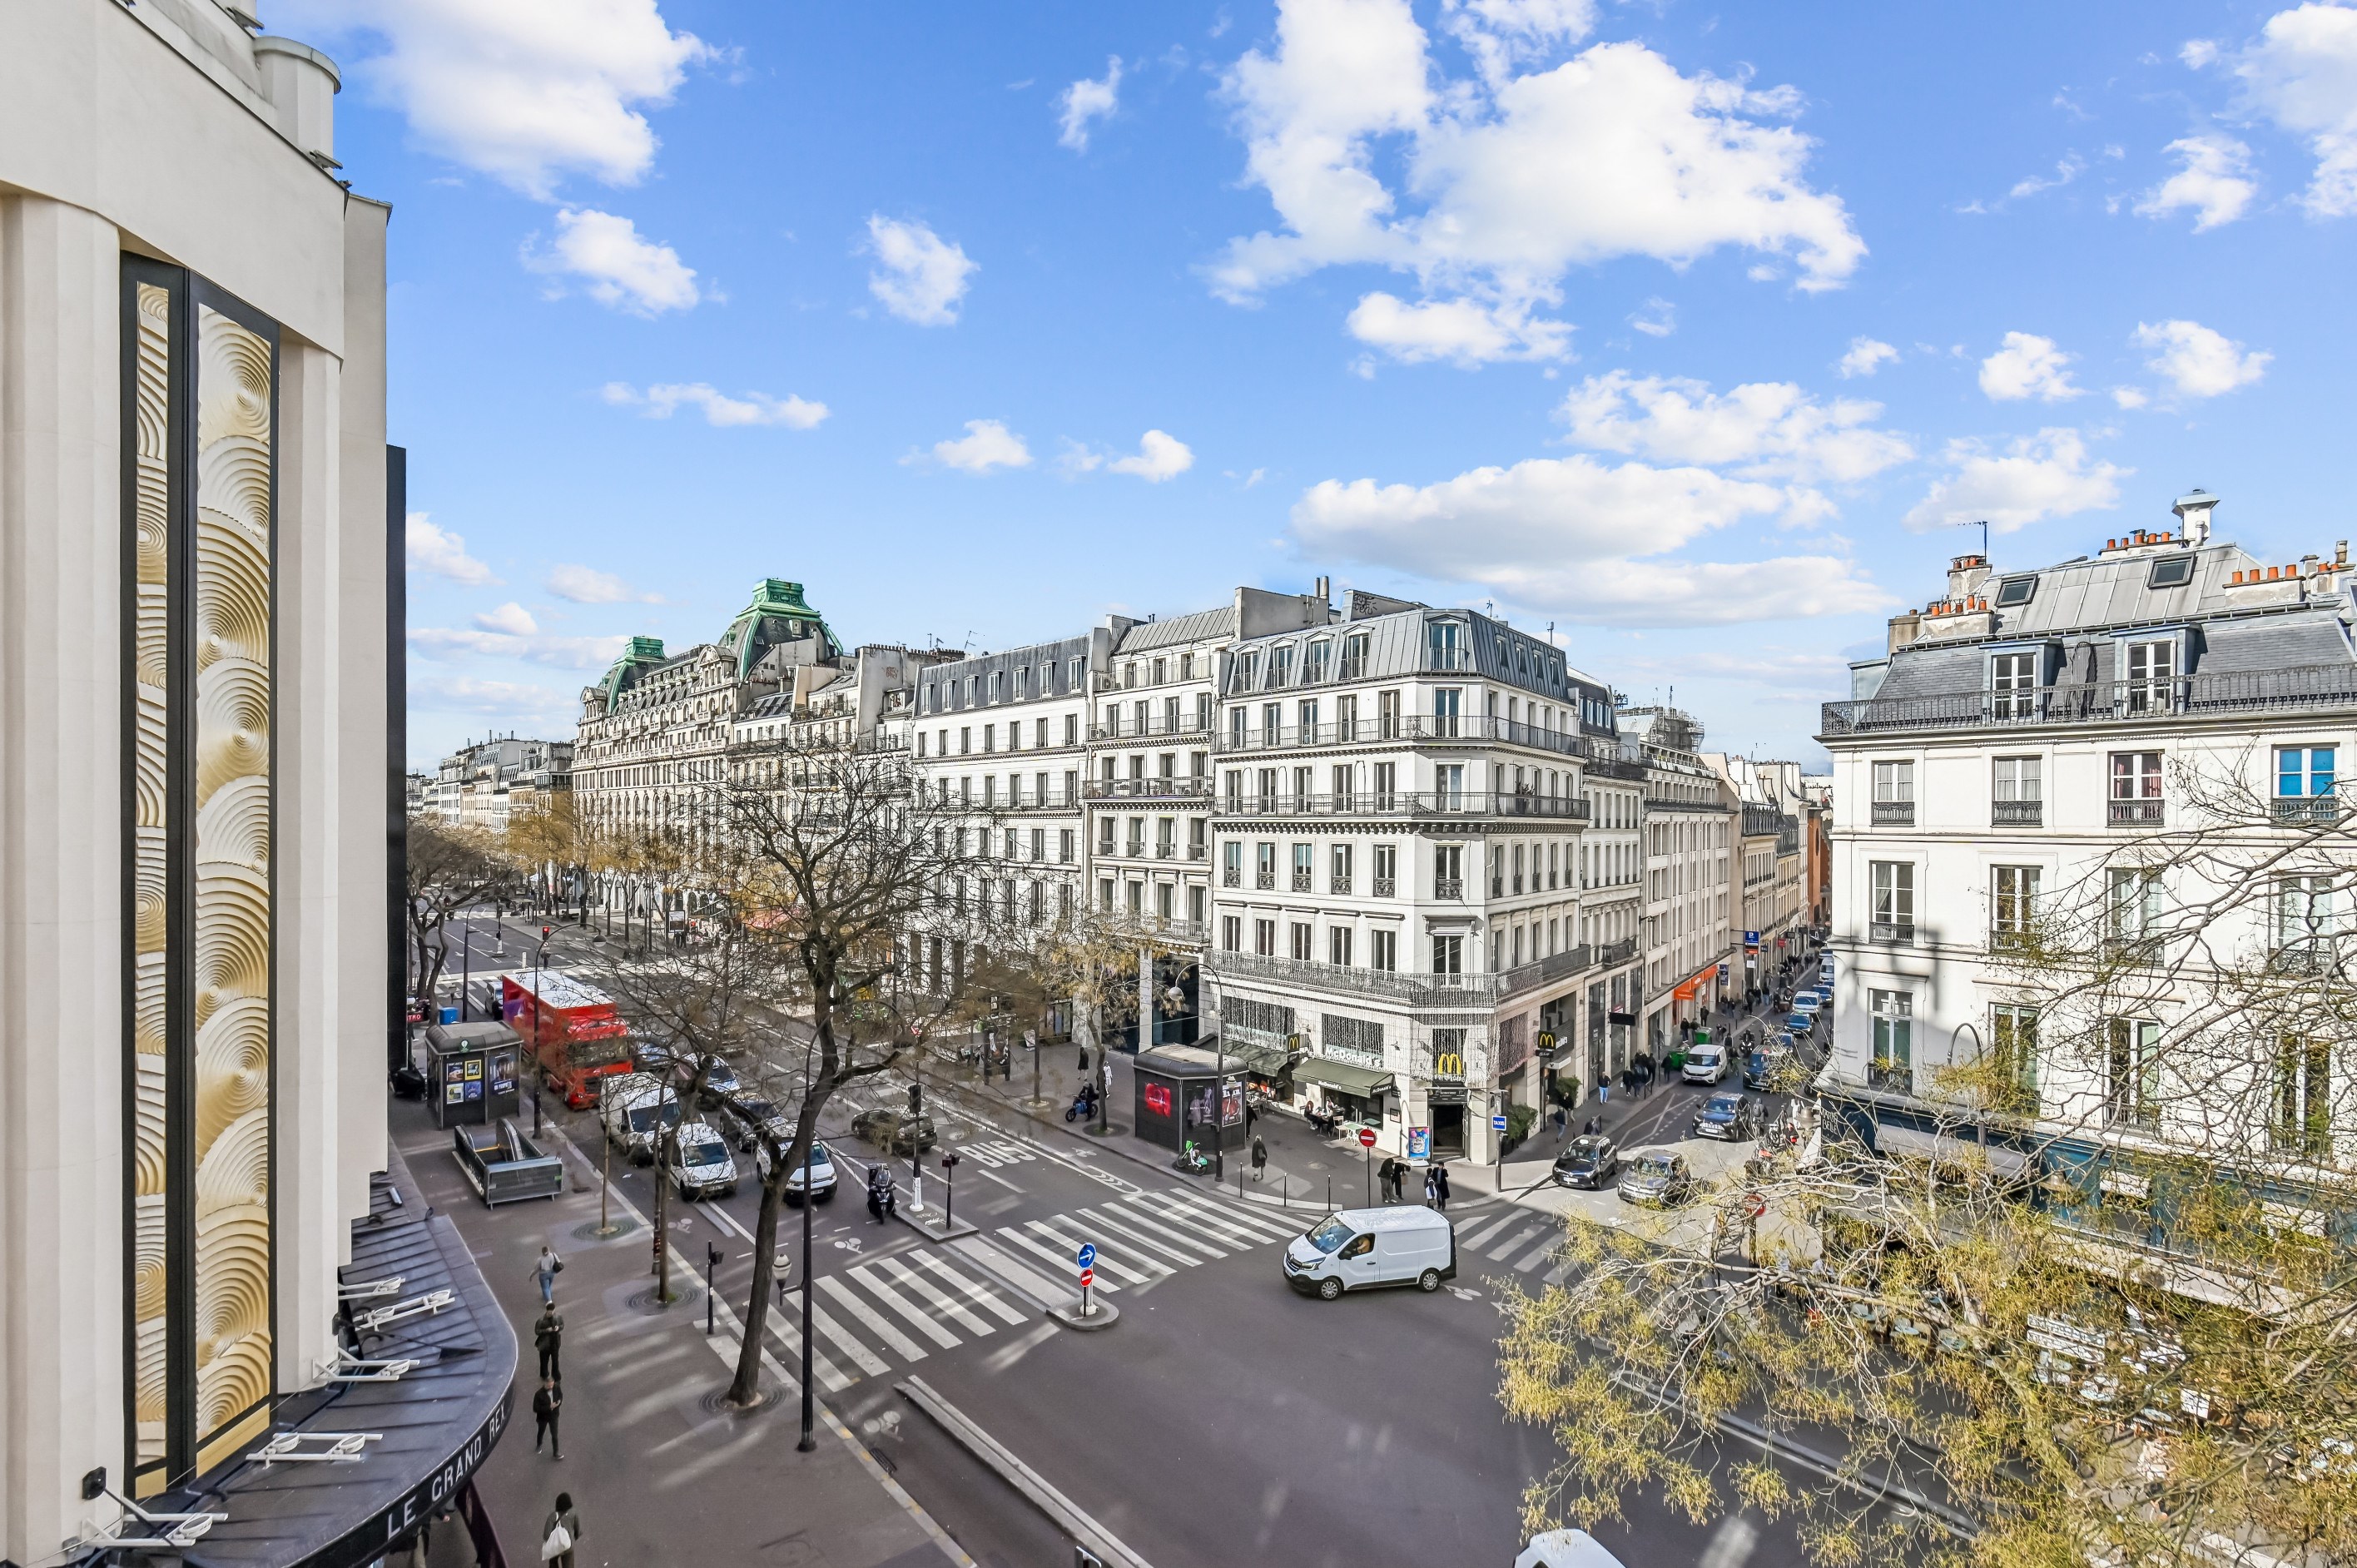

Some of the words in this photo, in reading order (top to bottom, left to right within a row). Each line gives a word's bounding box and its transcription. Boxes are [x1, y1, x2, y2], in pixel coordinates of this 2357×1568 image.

[1325, 1047, 1382, 1068] McDonald's
[1318, 1081, 1342, 1089] McDonald's
[1372, 1085, 1392, 1094] McDonald's
[1822, 1119, 1838, 1135] BELLE
[955, 1140, 1037, 1168] BUS
[388, 1496, 417, 1541] LE
[431, 1436, 482, 1501] GRAND
[489, 1402, 506, 1443] REX
